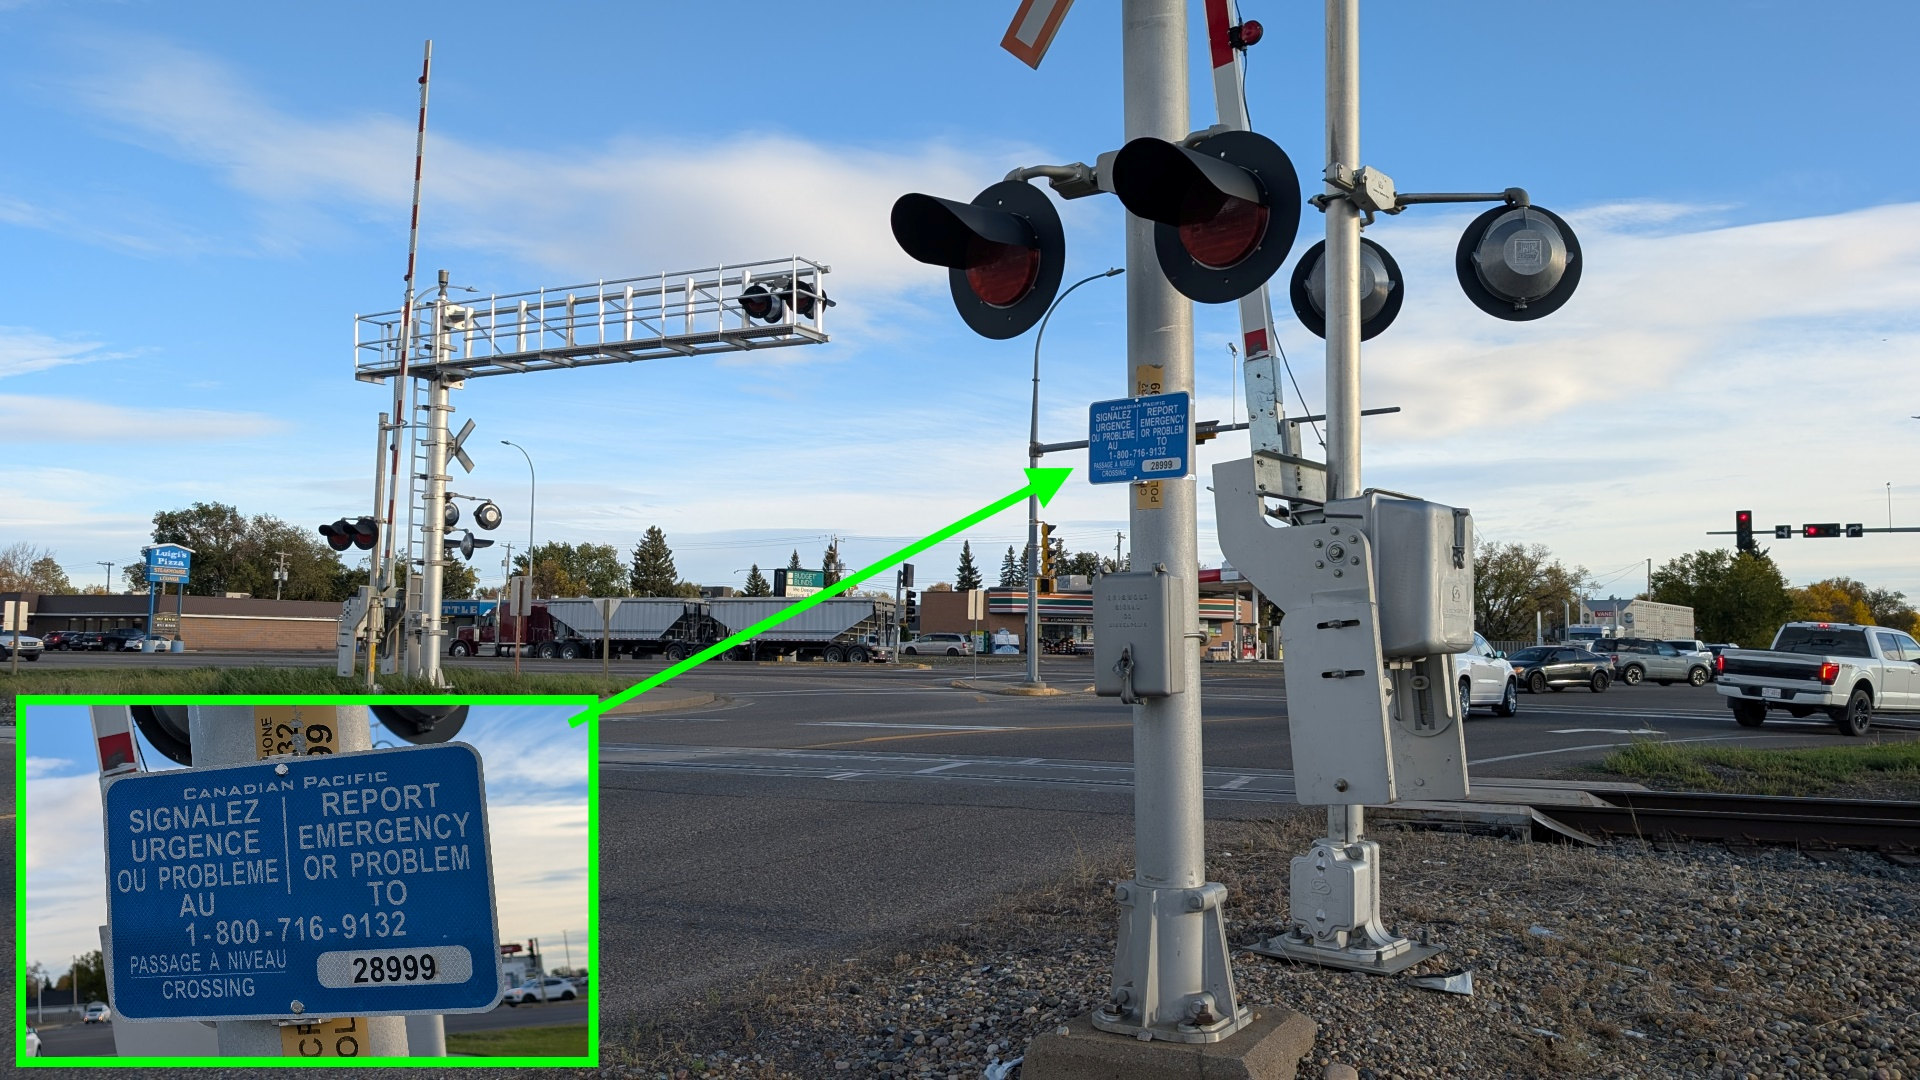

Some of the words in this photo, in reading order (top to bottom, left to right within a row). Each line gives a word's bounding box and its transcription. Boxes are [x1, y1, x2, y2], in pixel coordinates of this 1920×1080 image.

[1096, 410, 1132, 422] SIGNALEZ
[1146, 404, 1178, 416] REPORT
[1096, 420, 1130, 432] URGENCE
[1140, 414, 1184, 428] EMERGENCY
[1092, 434, 1100, 442] OU
[1140, 428, 1150, 438] OR
[1152, 424, 1184, 436] PROBLEM
[1108, 442, 1118, 450] AU
[1156, 436, 1168, 446] TO
[1120, 460, 1136, 468] NIVEAU
[1150, 460, 1172, 470] 28999
[1102, 468, 1126, 478] CROSSING
[156, 548, 186, 560] Luigi's
[158, 558, 184, 566] Pizza
[794, 572, 816, 580] BUDGET
[183, 780, 295, 801] CANADIAN
[303, 771, 389, 790] PACIFIC
[321, 782, 441, 817] REPORT
[129, 798, 261, 834] SIGNALEZ
[298, 811, 471, 850] EMERGENCY
[131, 829, 261, 863] URGENCE
[303, 854, 338, 881] OR
[350, 843, 471, 878] PROBLEM
[117, 867, 146, 893] OU
[158, 857, 279, 891] PROBLÈME
[366, 879, 408, 907] TO
[179, 891, 216, 918] AU
[185, 910, 407, 947] 1-800-716-9132
[130, 953, 202, 975] PASSAGE
[227, 949, 287, 971] NIVEAU
[352, 953, 436, 984] 28999
[162, 977, 256, 1000] CROSSING
